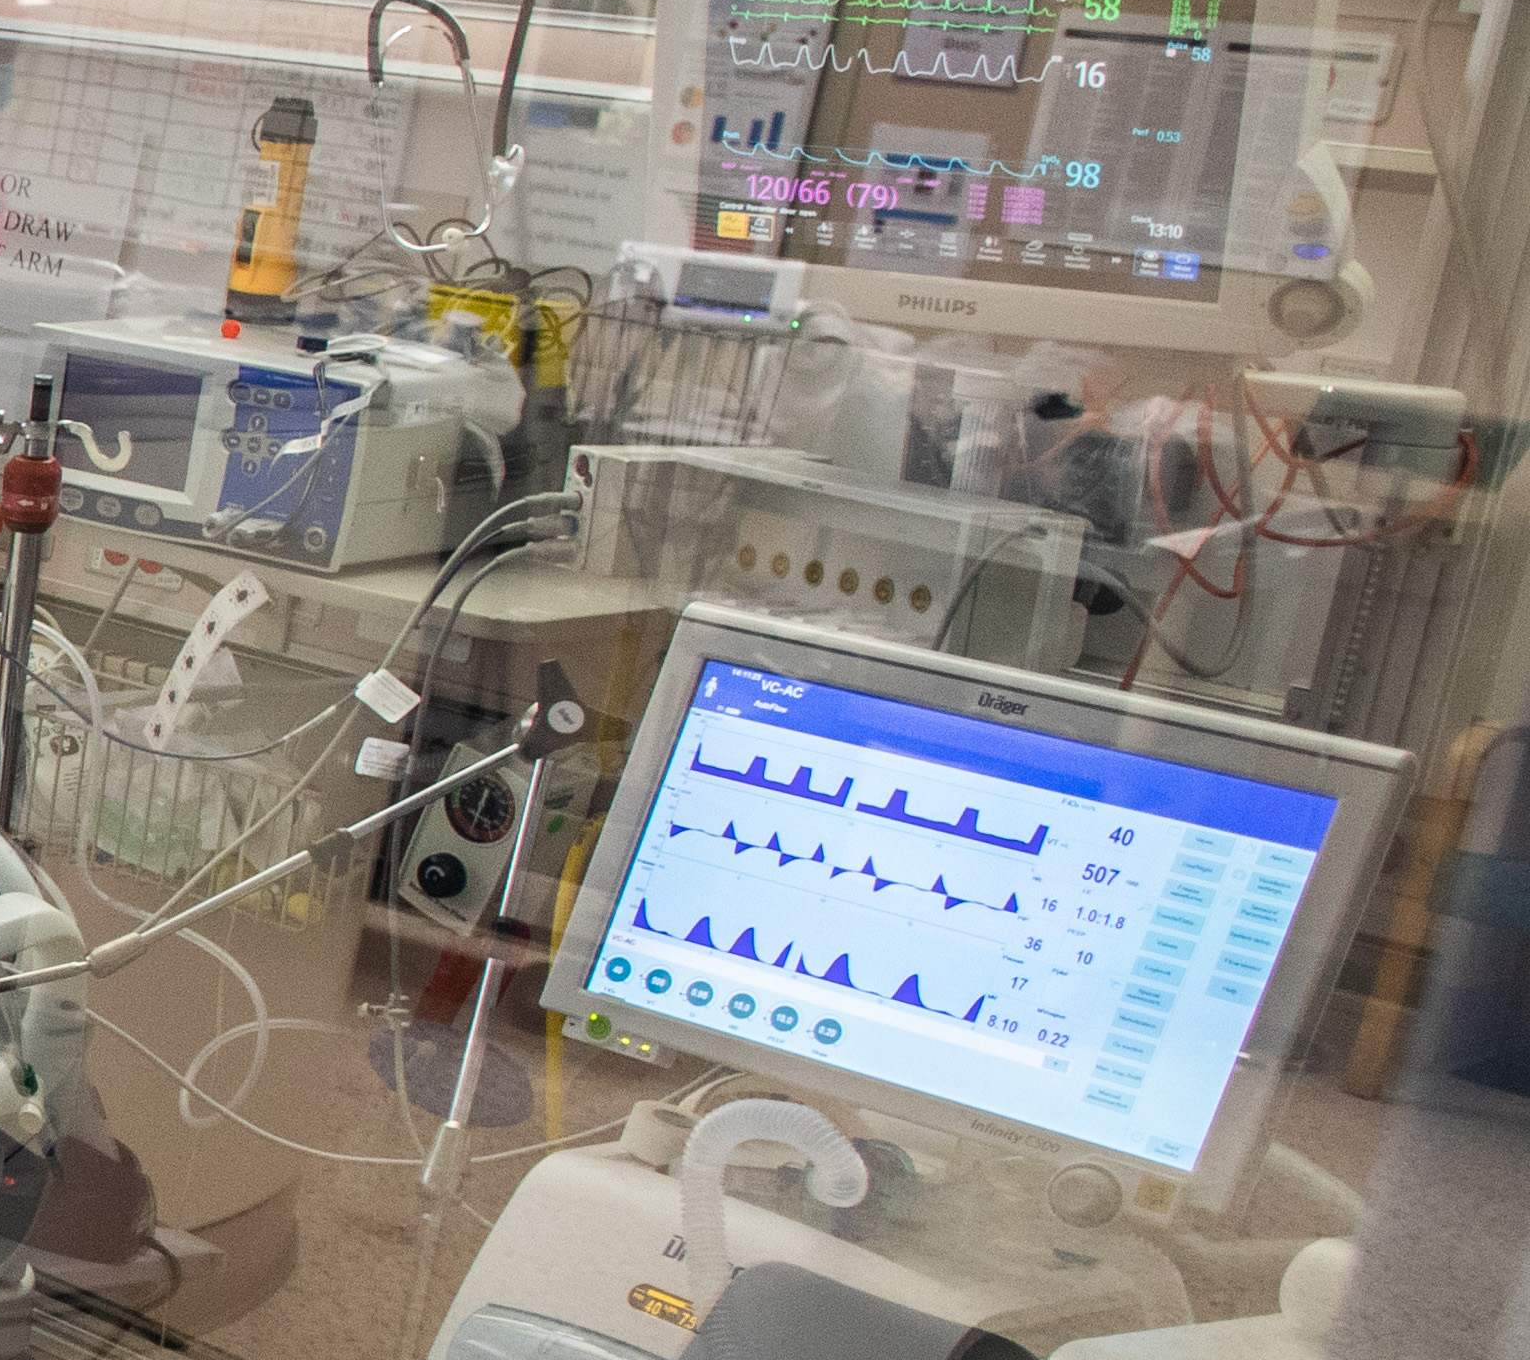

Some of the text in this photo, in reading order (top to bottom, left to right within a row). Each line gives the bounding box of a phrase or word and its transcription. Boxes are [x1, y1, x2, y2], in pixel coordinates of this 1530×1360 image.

[1191, 46, 1213, 63] 58
[1074, 60, 1107, 89] 16
[0, 172, 32, 198] OR
[1064, 160, 1102, 189] 98
[746, 173, 900, 209] 120/66 (79)
[3, 209, 76, 243] DRAW
[1148, 222, 1184, 240] 13:10
[10, 247, 65, 278] ARM
[897, 294, 978, 316] PHILIPS
[761, 679, 805, 700] VC-AC
[978, 691, 1028, 716] Dräger
[1108, 826, 1135, 848] 40
[1081, 862, 1121, 887] 507
[1040, 896, 1059, 913] 16
[1075, 906, 1126, 930] 1.0:1.8
[1023, 936, 1043, 952] 36
[1075, 950, 1094, 966] 10
[1009, 976, 1029, 992] 17
[986, 1014, 1019, 1034] 8.10
[1036, 1028, 1070, 1049] 0.22
[970, 1118, 1023, 1144] Infinity
